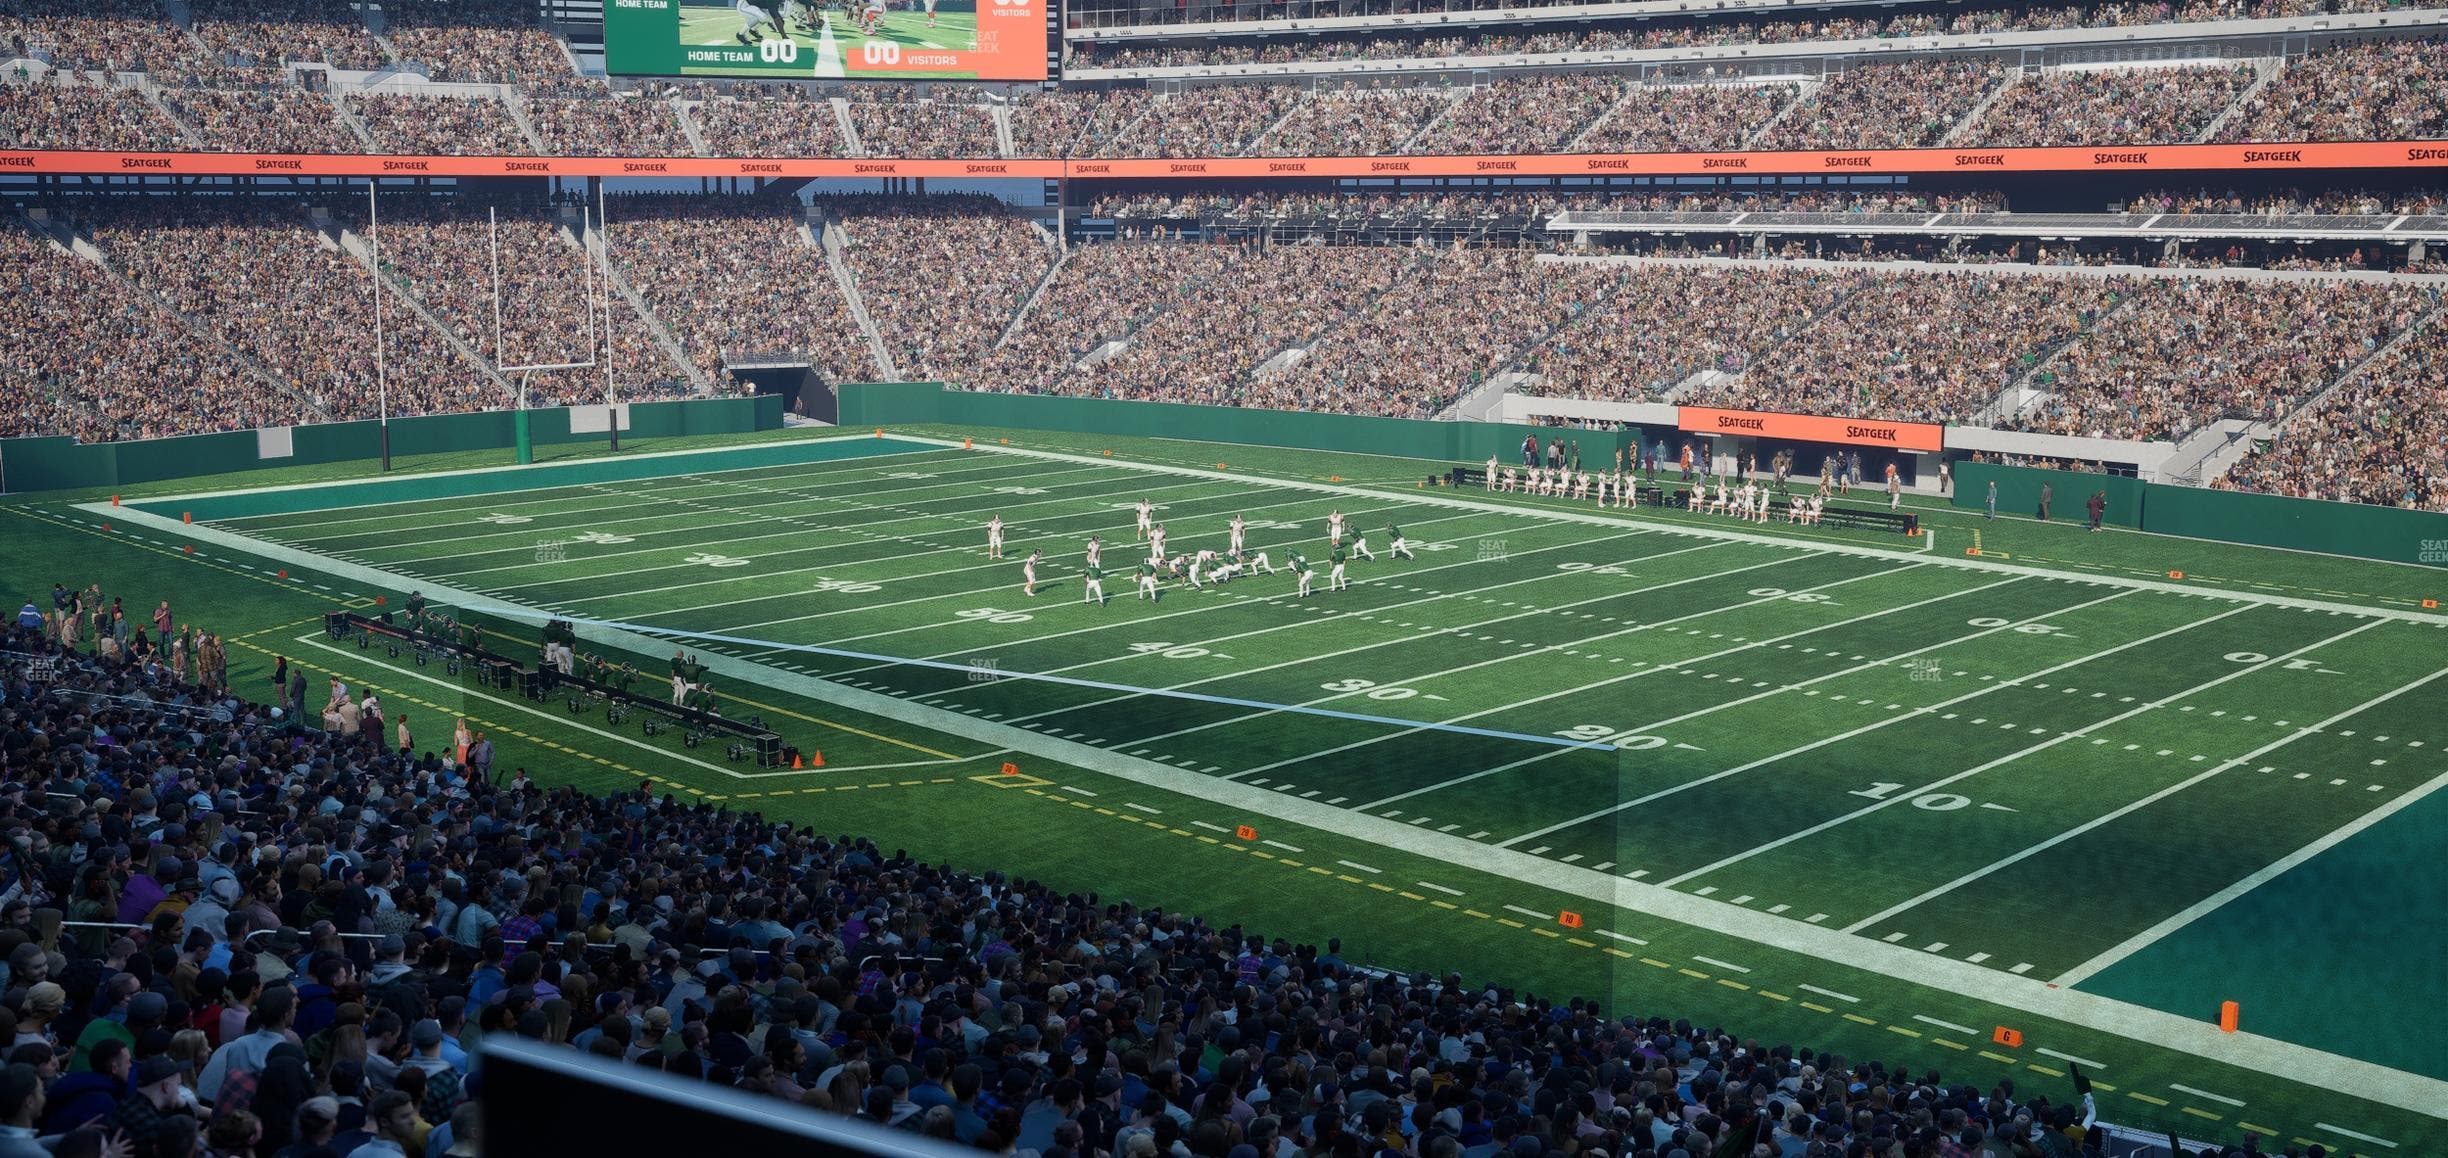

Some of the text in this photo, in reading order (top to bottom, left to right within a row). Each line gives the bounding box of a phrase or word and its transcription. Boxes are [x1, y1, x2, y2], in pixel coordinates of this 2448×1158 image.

[615, 0, 668, 9] HOME TEAM
[992, 9, 1031, 17] VISITORS
[688, 50, 754, 62] HOME TEAM
[760, 38, 798, 64] 00
[863, 40, 901, 65] 00
[907, 55, 958, 66] VISITORS
[1954, 154, 2004, 166] SEATGEEK
[2094, 152, 2148, 164] SEATGEEK
[2243, 150, 2302, 163] SEATGEEK
[2408, 148, 2448, 161] SEATG
[121, 158, 172, 169] SEATGEEK
[255, 160, 303, 170] SEATGEEK
[383, 160, 429, 171] SEATGEEK
[505, 162, 550, 172] SEATGEEK
[1371, 161, 1410, 171] SEATGEEK
[1477, 160, 1517, 171] SEATGEEK
[1589, 159, 1629, 169] SEATGEEK
[1703, 158, 1747, 168] SEATGEEK
[1825, 156, 1872, 167] SEATGEEK
[623, 163, 667, 172] SEATGEEK
[740, 164, 783, 173] SEATGEEK
[854, 164, 896, 174] SEATGEEK
[966, 165, 1007, 173] SEATGEEK
[1076, 165, 1109, 174] SEATGEEK
[1170, 164, 1206, 173] SEATGEEK
[1269, 163, 1306, 172] SEATGEEK
[1718, 415, 1764, 431] SEATGEEK
[1846, 425, 1897, 442] SEATGEEK
[955, 607, 1034, 623] 50
[1127, 641, 1210, 659] 40
[1320, 678, 1417, 701] 30
[1554, 724, 1668, 751] 20
[1848, 781, 1972, 811] 10
[1565, 914, 1574, 924] 10
[2003, 1030, 2011, 1042] G
